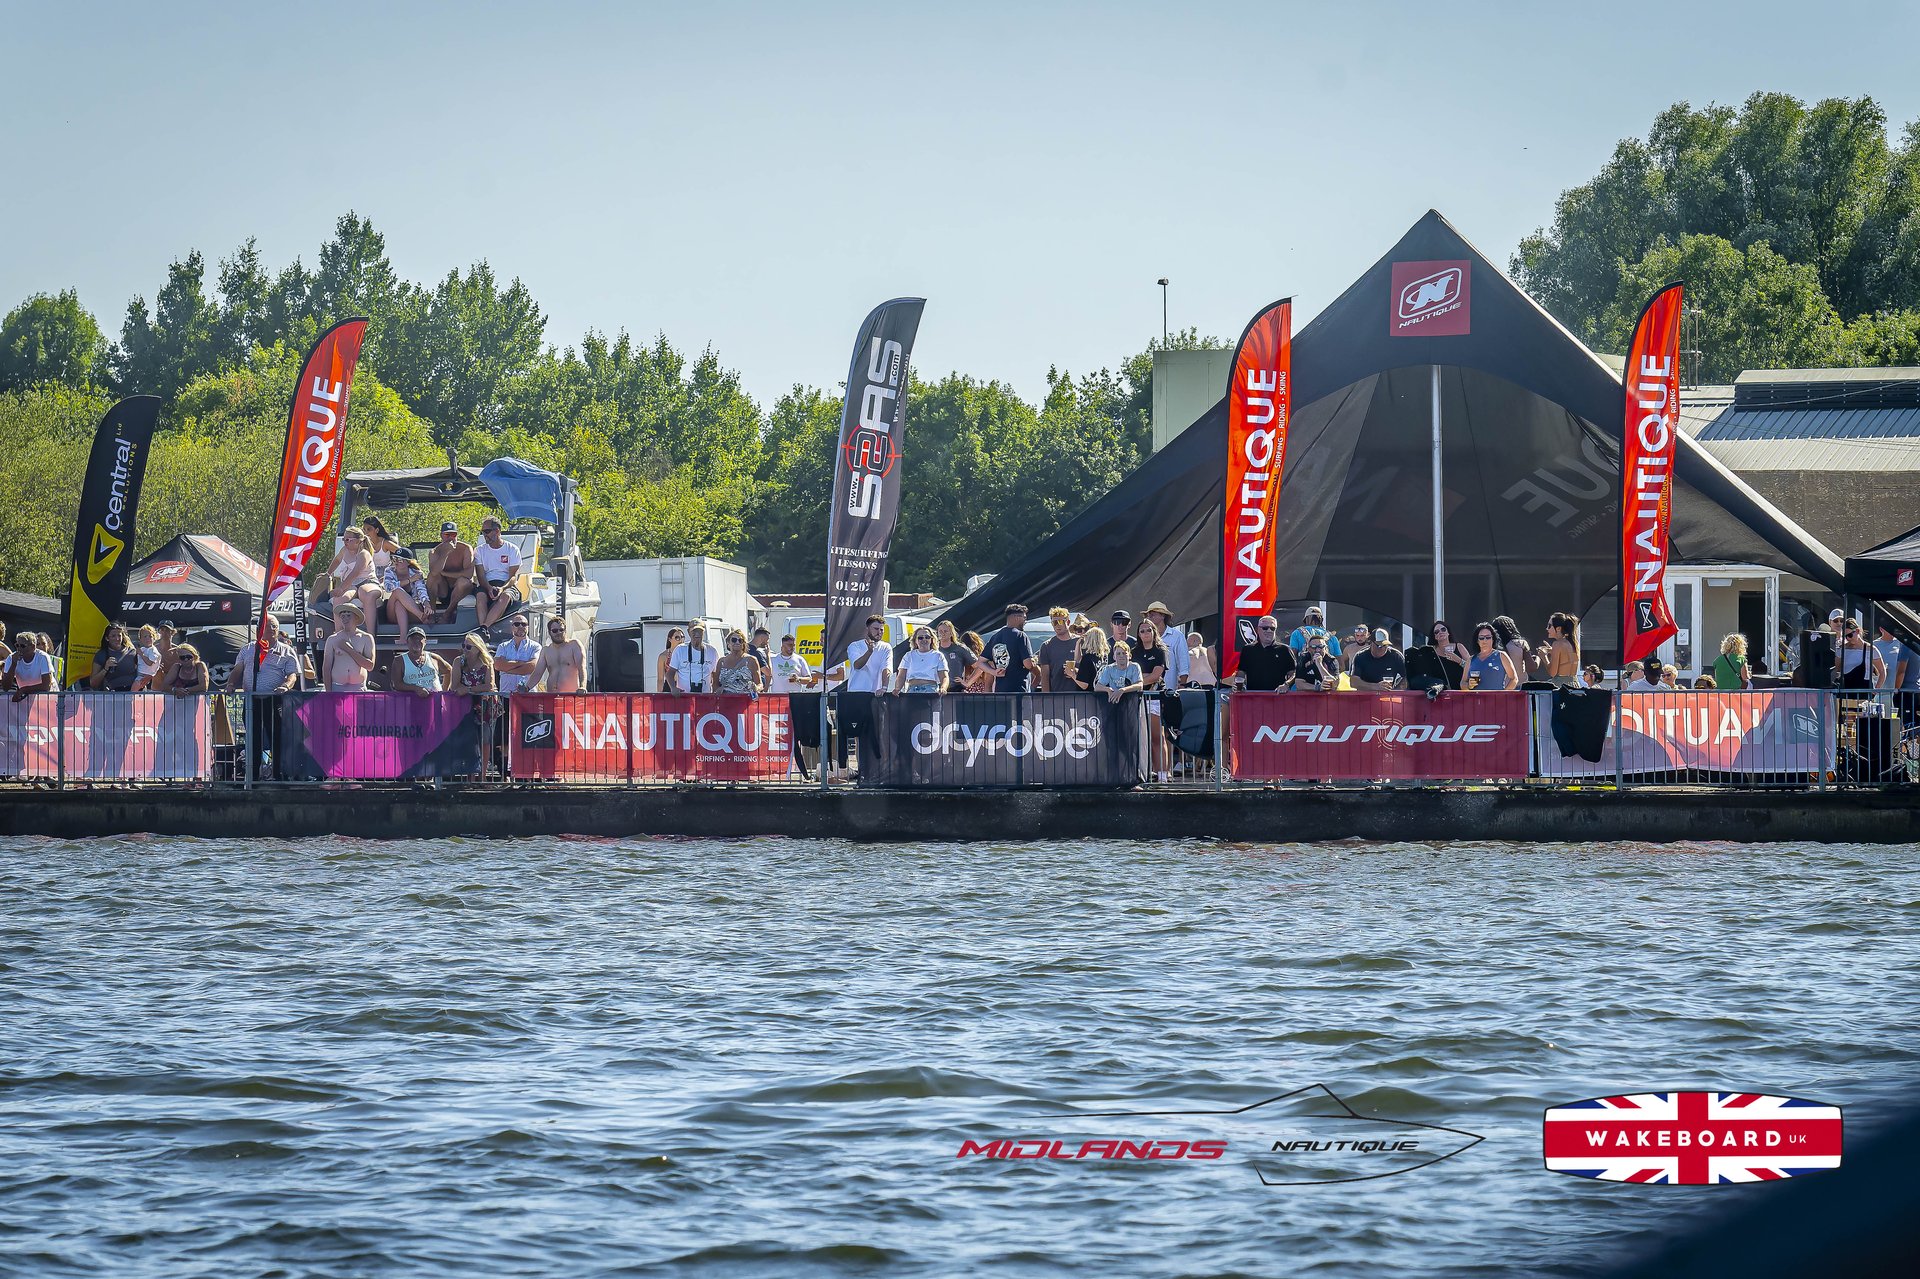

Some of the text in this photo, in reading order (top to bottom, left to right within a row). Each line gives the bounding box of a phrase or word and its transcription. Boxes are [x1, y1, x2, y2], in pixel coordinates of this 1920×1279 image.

[1399, 302, 1462, 328] NAUTIQUE
[122, 443, 138, 510] SOLUTIONS
[330, 448, 340, 478] SURFING
[1635, 354, 1671, 593] NAUTIQUE
[105, 437, 132, 531] central
[1235, 368, 1277, 610] NAUTIQUE
[838, 558, 878, 570] LESSONS
[294, 589, 305, 643] NAUTIQUE
[799, 639, 824, 647] Arn
[337, 725, 424, 739] #GOTYOURBACK
[561, 712, 789, 754] NAUTIQUE
[1252, 724, 1502, 745] NAUTIQUE
[695, 755, 789, 763] SURFING RIDING SKIING
